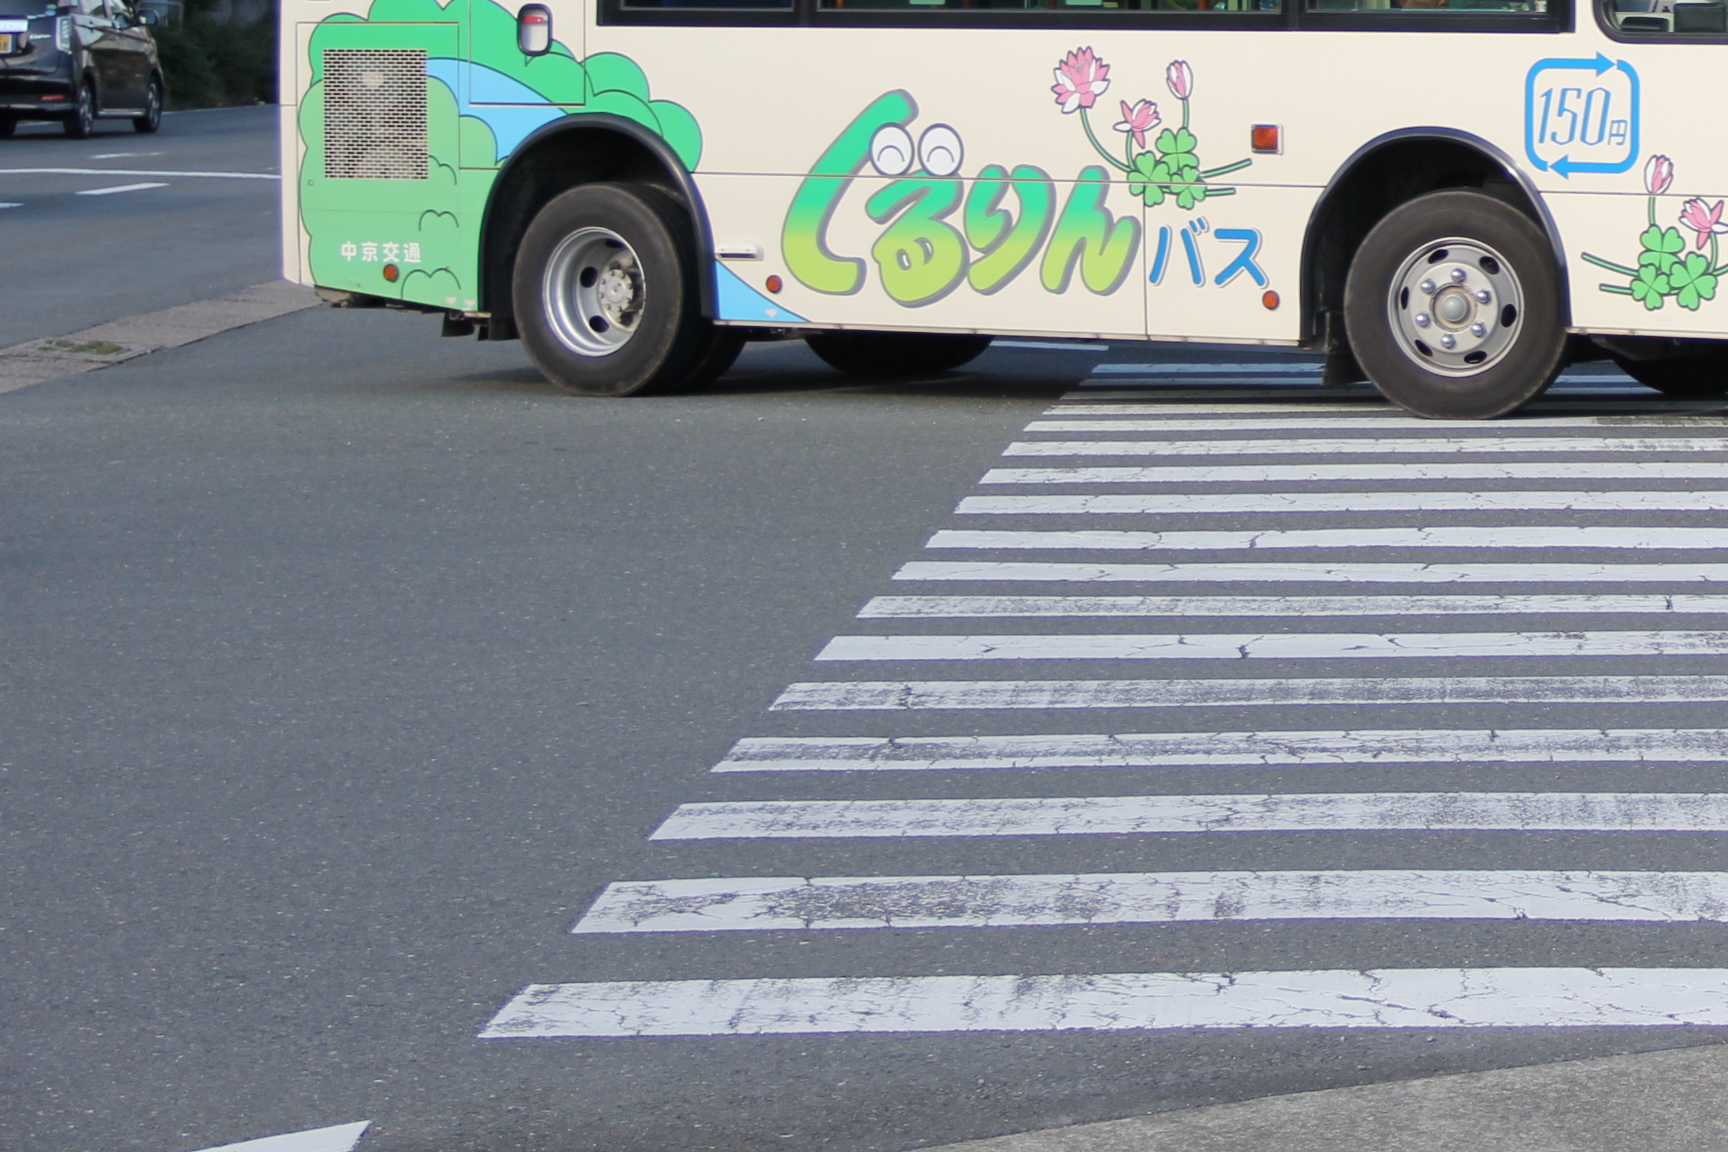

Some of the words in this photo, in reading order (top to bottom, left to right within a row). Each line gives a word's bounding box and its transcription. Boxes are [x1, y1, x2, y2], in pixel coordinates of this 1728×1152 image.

[1538, 87, 1628, 146] 150円
[341, 241, 421, 263] 中京交通
